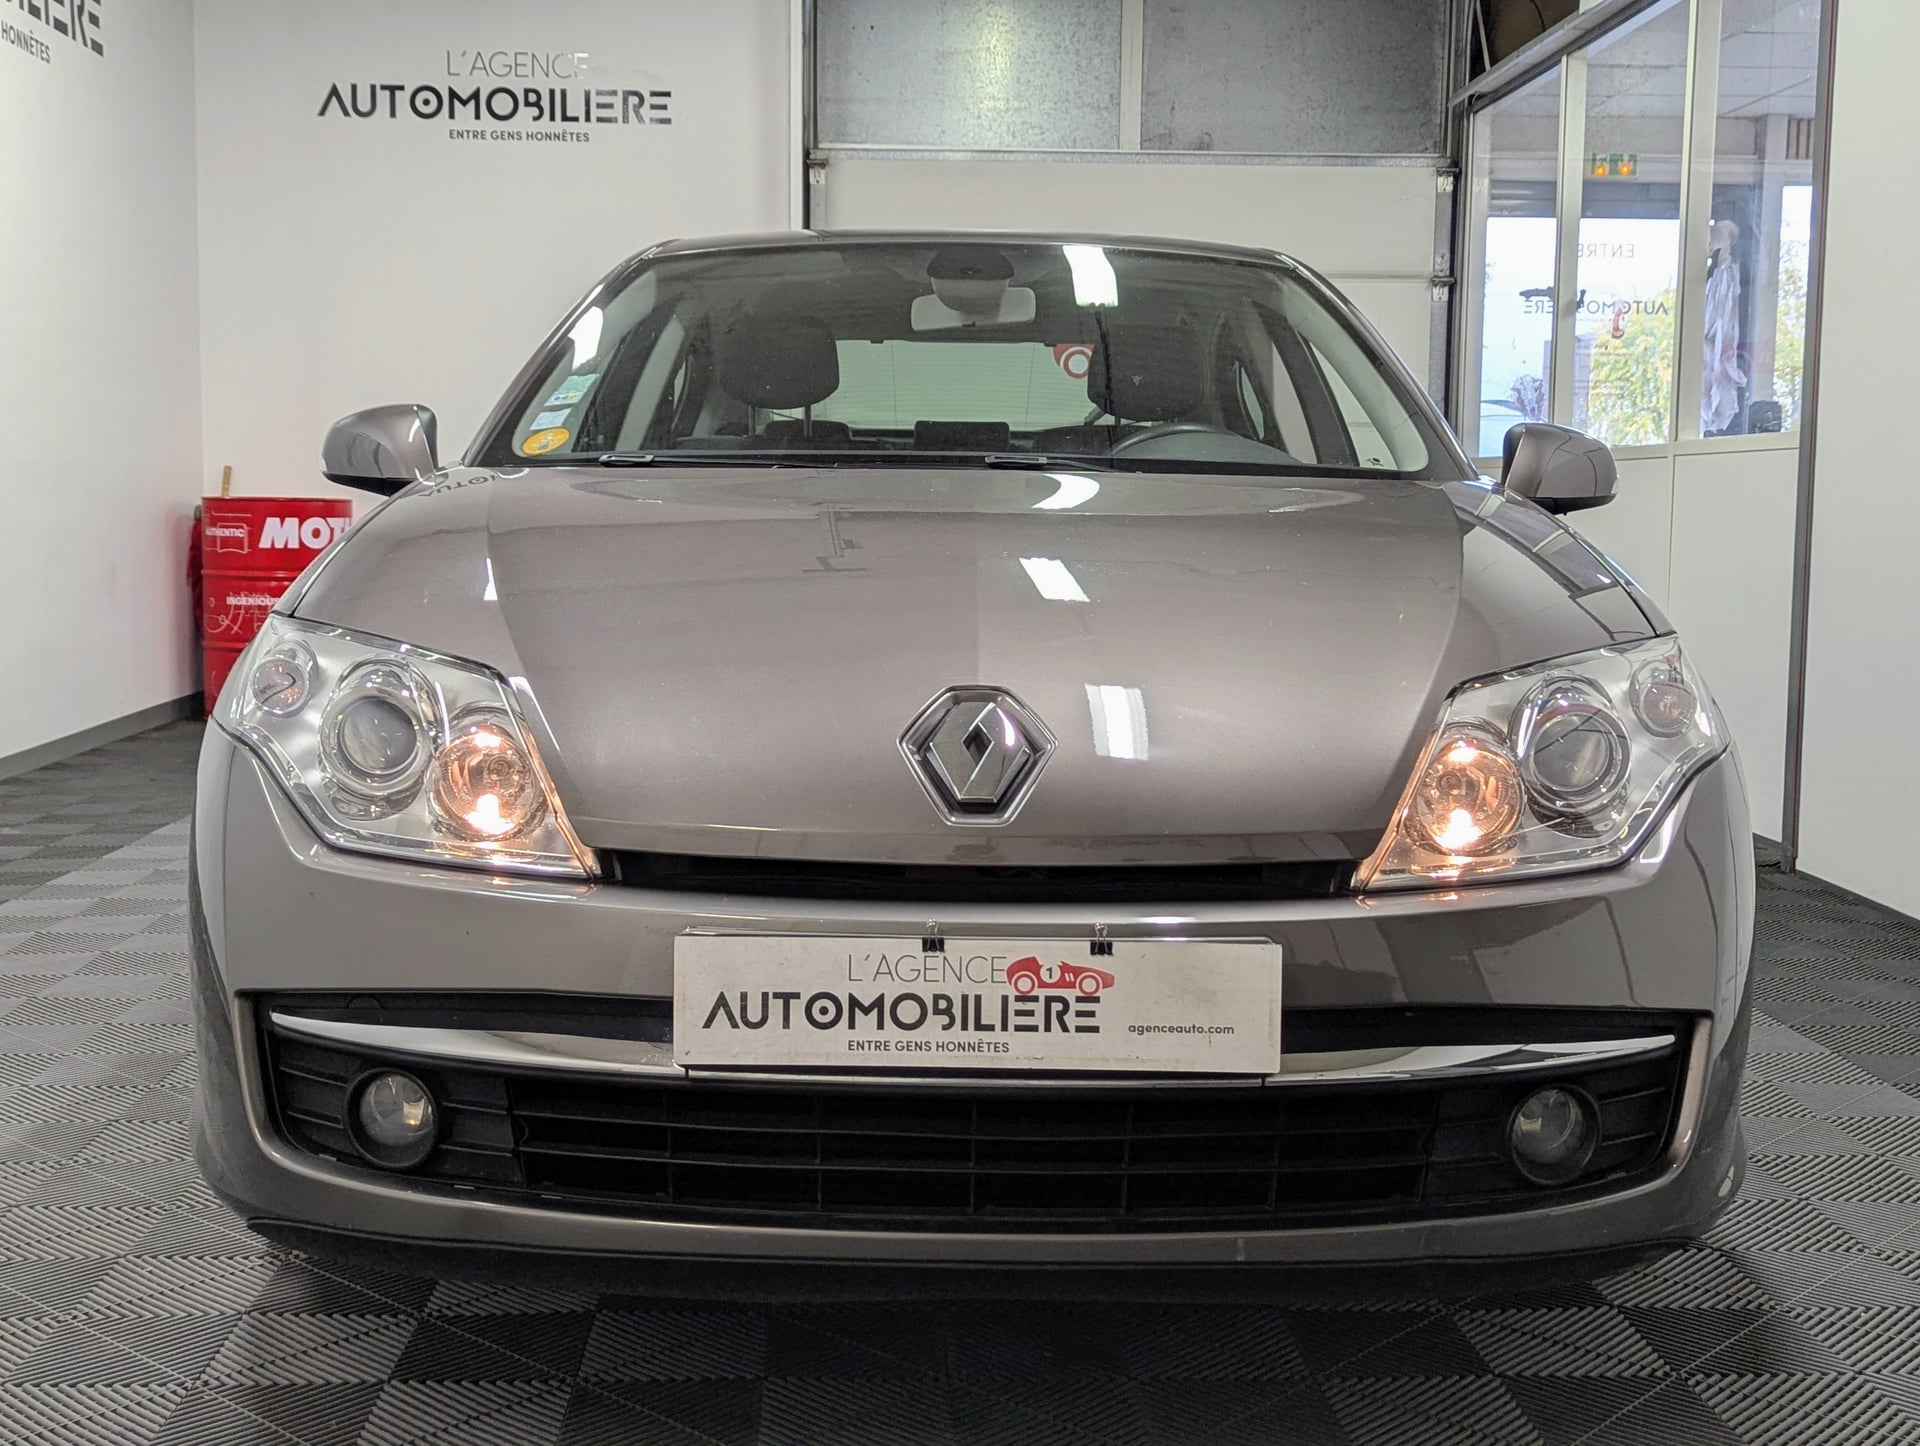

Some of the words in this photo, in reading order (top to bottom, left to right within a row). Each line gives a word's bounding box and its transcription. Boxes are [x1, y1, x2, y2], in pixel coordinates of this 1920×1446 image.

[449, 129, 487, 140] ENTRE
[490, 130, 523, 141] GENS
[526, 129, 590, 142] HONNÊTES
[258, 517, 351, 549] MOT
[848, 954, 1007, 984] L'AGENCE
[701, 991, 1101, 1034] AUTOMOBILIERE
[1128, 1024, 1235, 1036] agenceauto.com
[848, 1039, 890, 1051] ENTRE
[894, 1040, 932, 1052] GENS
[936, 1038, 1010, 1053] HONNÊTES
